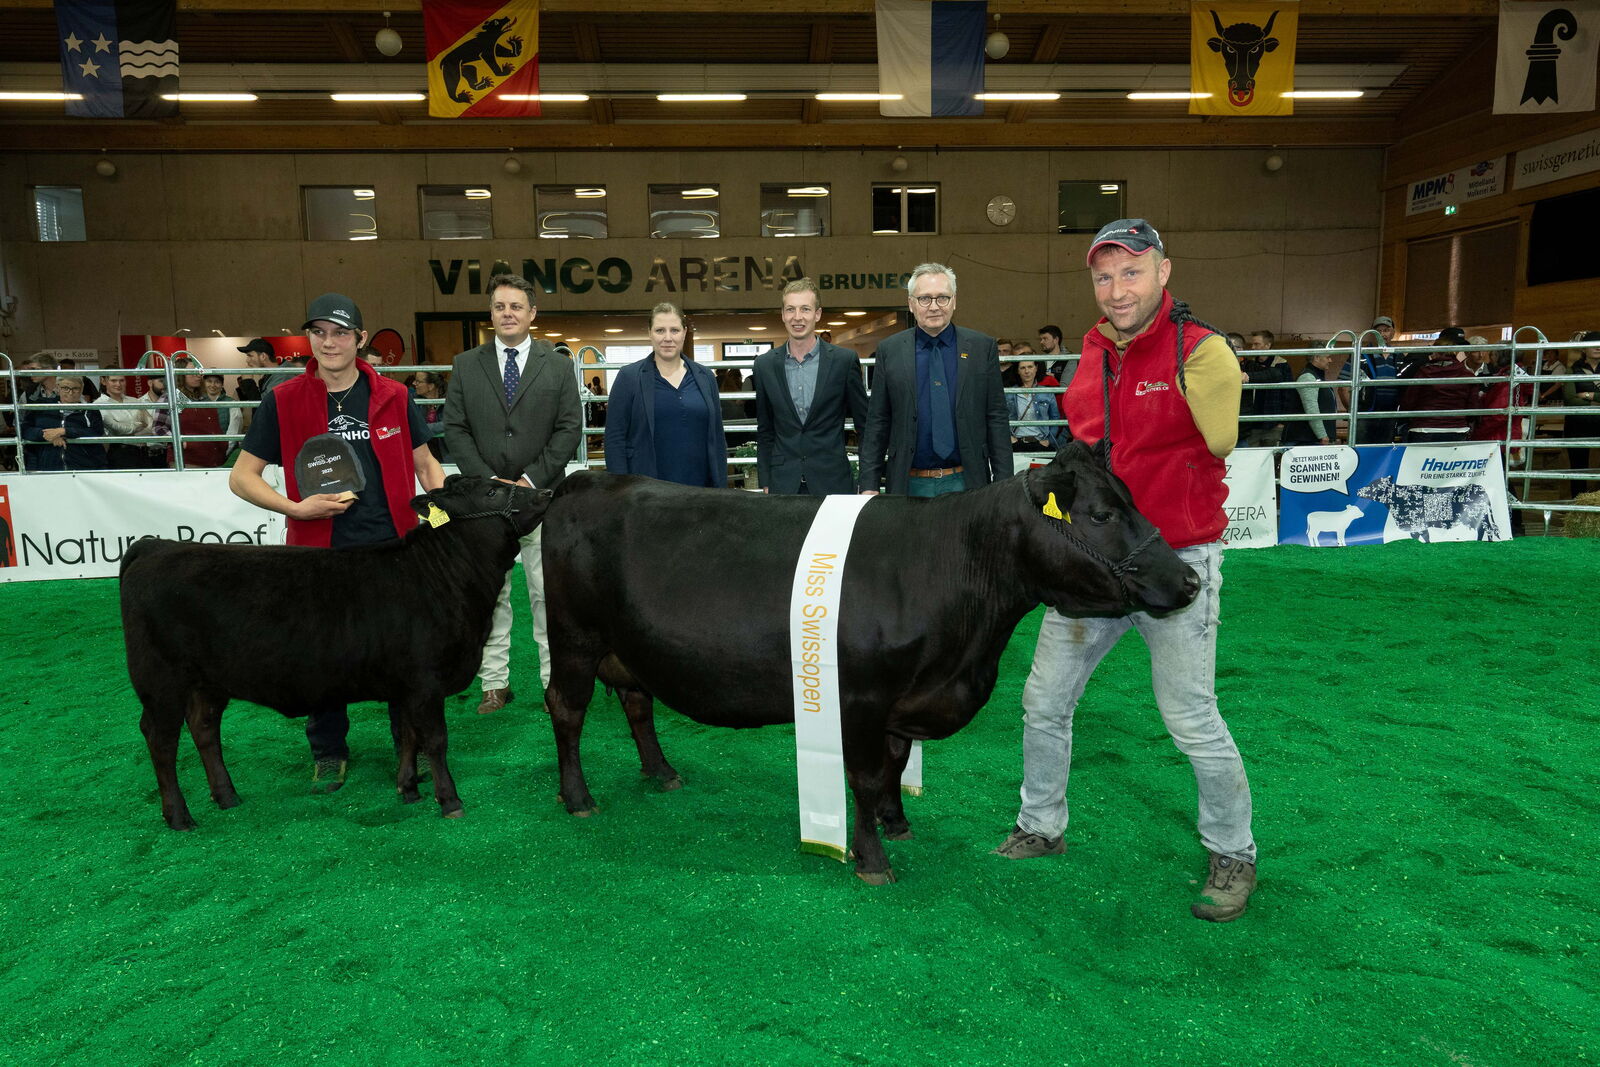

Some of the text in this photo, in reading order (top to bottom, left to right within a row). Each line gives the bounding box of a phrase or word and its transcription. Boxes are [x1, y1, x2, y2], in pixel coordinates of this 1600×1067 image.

[1412, 176, 1447, 201] MPM
[428, 257, 633, 295] VIANCO
[645, 256, 805, 293] ARENA
[72, 350, 95, 358] Kasse
[1289, 461, 1340, 473] SCANNEN &
[1290, 472, 1340, 483] GEWINNEN!
[1445, 471, 1466, 479] STARKE
[1223, 505, 1267, 521] ZERA
[1222, 527, 1252, 542] ZRA
[21, 529, 160, 567] Natur
[797, 553, 837, 714] Miss Swissopen
